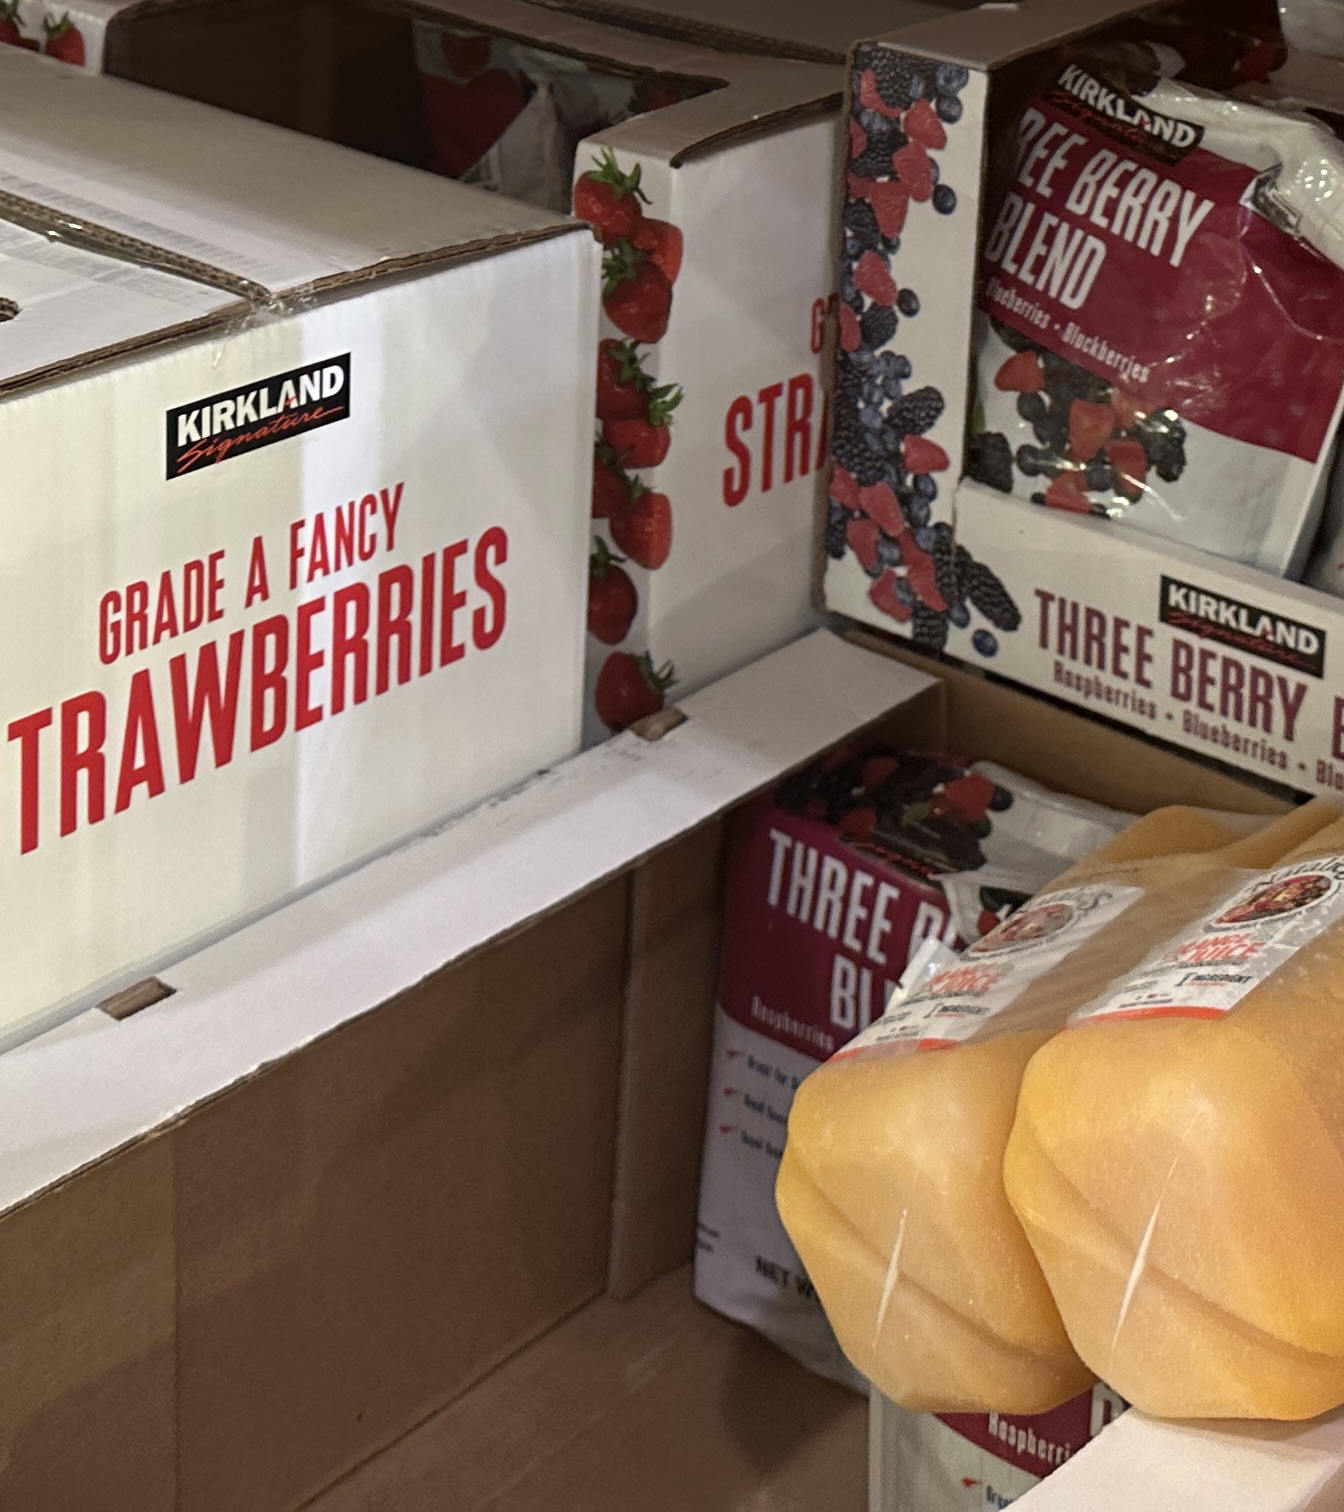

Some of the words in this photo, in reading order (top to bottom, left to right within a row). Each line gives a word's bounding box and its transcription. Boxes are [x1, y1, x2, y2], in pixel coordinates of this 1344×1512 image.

[1058, 64, 1196, 148] KIRKLAND
[983, 191, 1107, 310] BLEND
[1064, 148, 1216, 269] BERRY
[176, 364, 345, 448] KIRKLAND
[98, 549, 225, 666] GRADE
[244, 536, 270, 608] A
[289, 482, 405, 590] FANCY
[1167, 583, 1320, 656] KIRKLAND
[1034, 588, 1154, 690] THREE
[1169, 637, 1309, 742] BERRY
[1053, 659, 1156, 721] Raspberries
[1182, 708, 1289, 771] Blueberries
[767, 827, 900, 965] THREE
